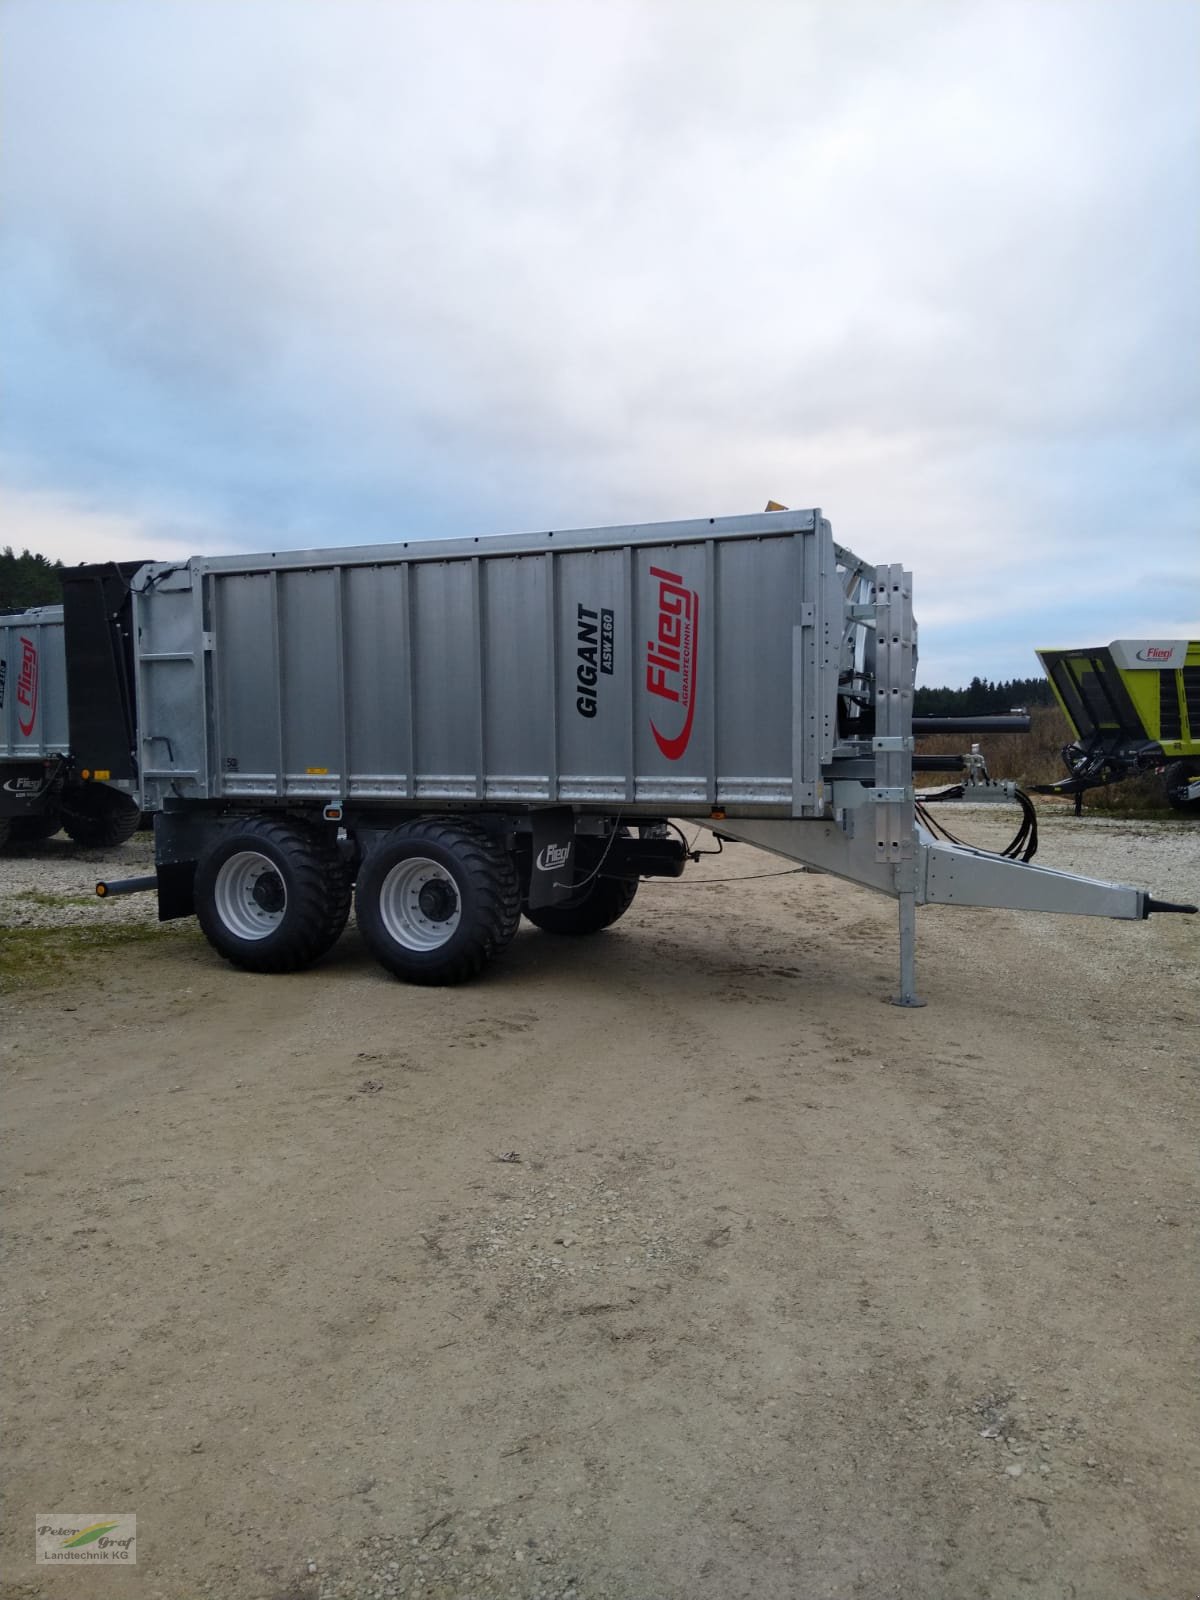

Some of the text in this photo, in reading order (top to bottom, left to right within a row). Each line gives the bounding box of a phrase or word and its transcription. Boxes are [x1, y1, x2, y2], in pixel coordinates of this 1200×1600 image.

[577, 603, 598, 718] GIGANT
[602, 615, 613, 669] ASW 160
[647, 566, 691, 702] Fliegl
[682, 621, 691, 707] AGRARTECHNIK
[1147, 648, 1173, 659] Fliegl
[18, 637, 37, 706] Fliegl
[16, 777, 43, 791] Fliegl
[546, 841, 571, 864] Fliegl
